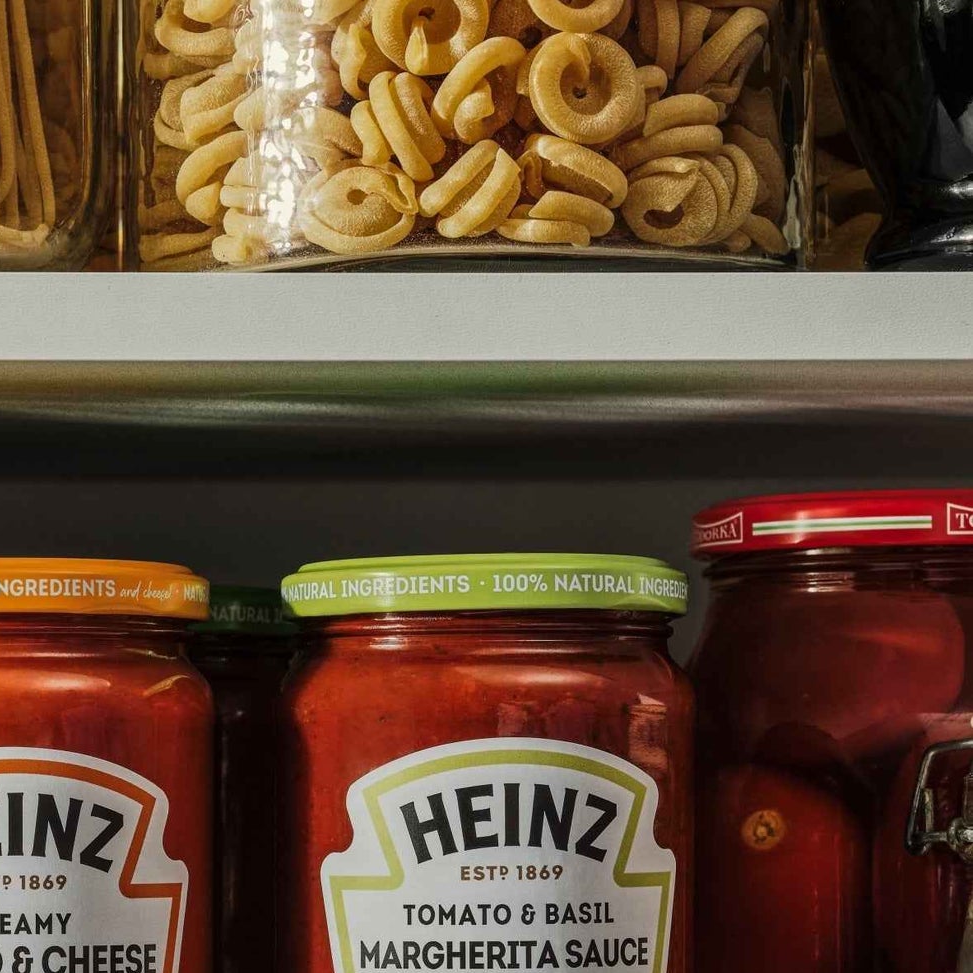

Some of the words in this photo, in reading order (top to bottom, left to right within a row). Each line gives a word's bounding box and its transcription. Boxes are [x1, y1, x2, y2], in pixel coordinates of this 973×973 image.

[120, 581, 142, 600] and
[289, 581, 336, 602] NATURAL
[341, 575, 470, 597] INGREDIENTS
[493, 574, 548, 592] 100%
[554, 574, 635, 594] NATURAL
[399, 783, 618, 865] HEINZ
[19, 874, 67, 890] 1869
[516, 865, 564, 880] 1869
[403, 903, 512, 926] TOMATO
[521, 903, 536, 925] &
[545, 901, 614, 924] BASIL
[360, 940, 559, 970] MARGHERITA
[565, 937, 648, 968] SAUCE
